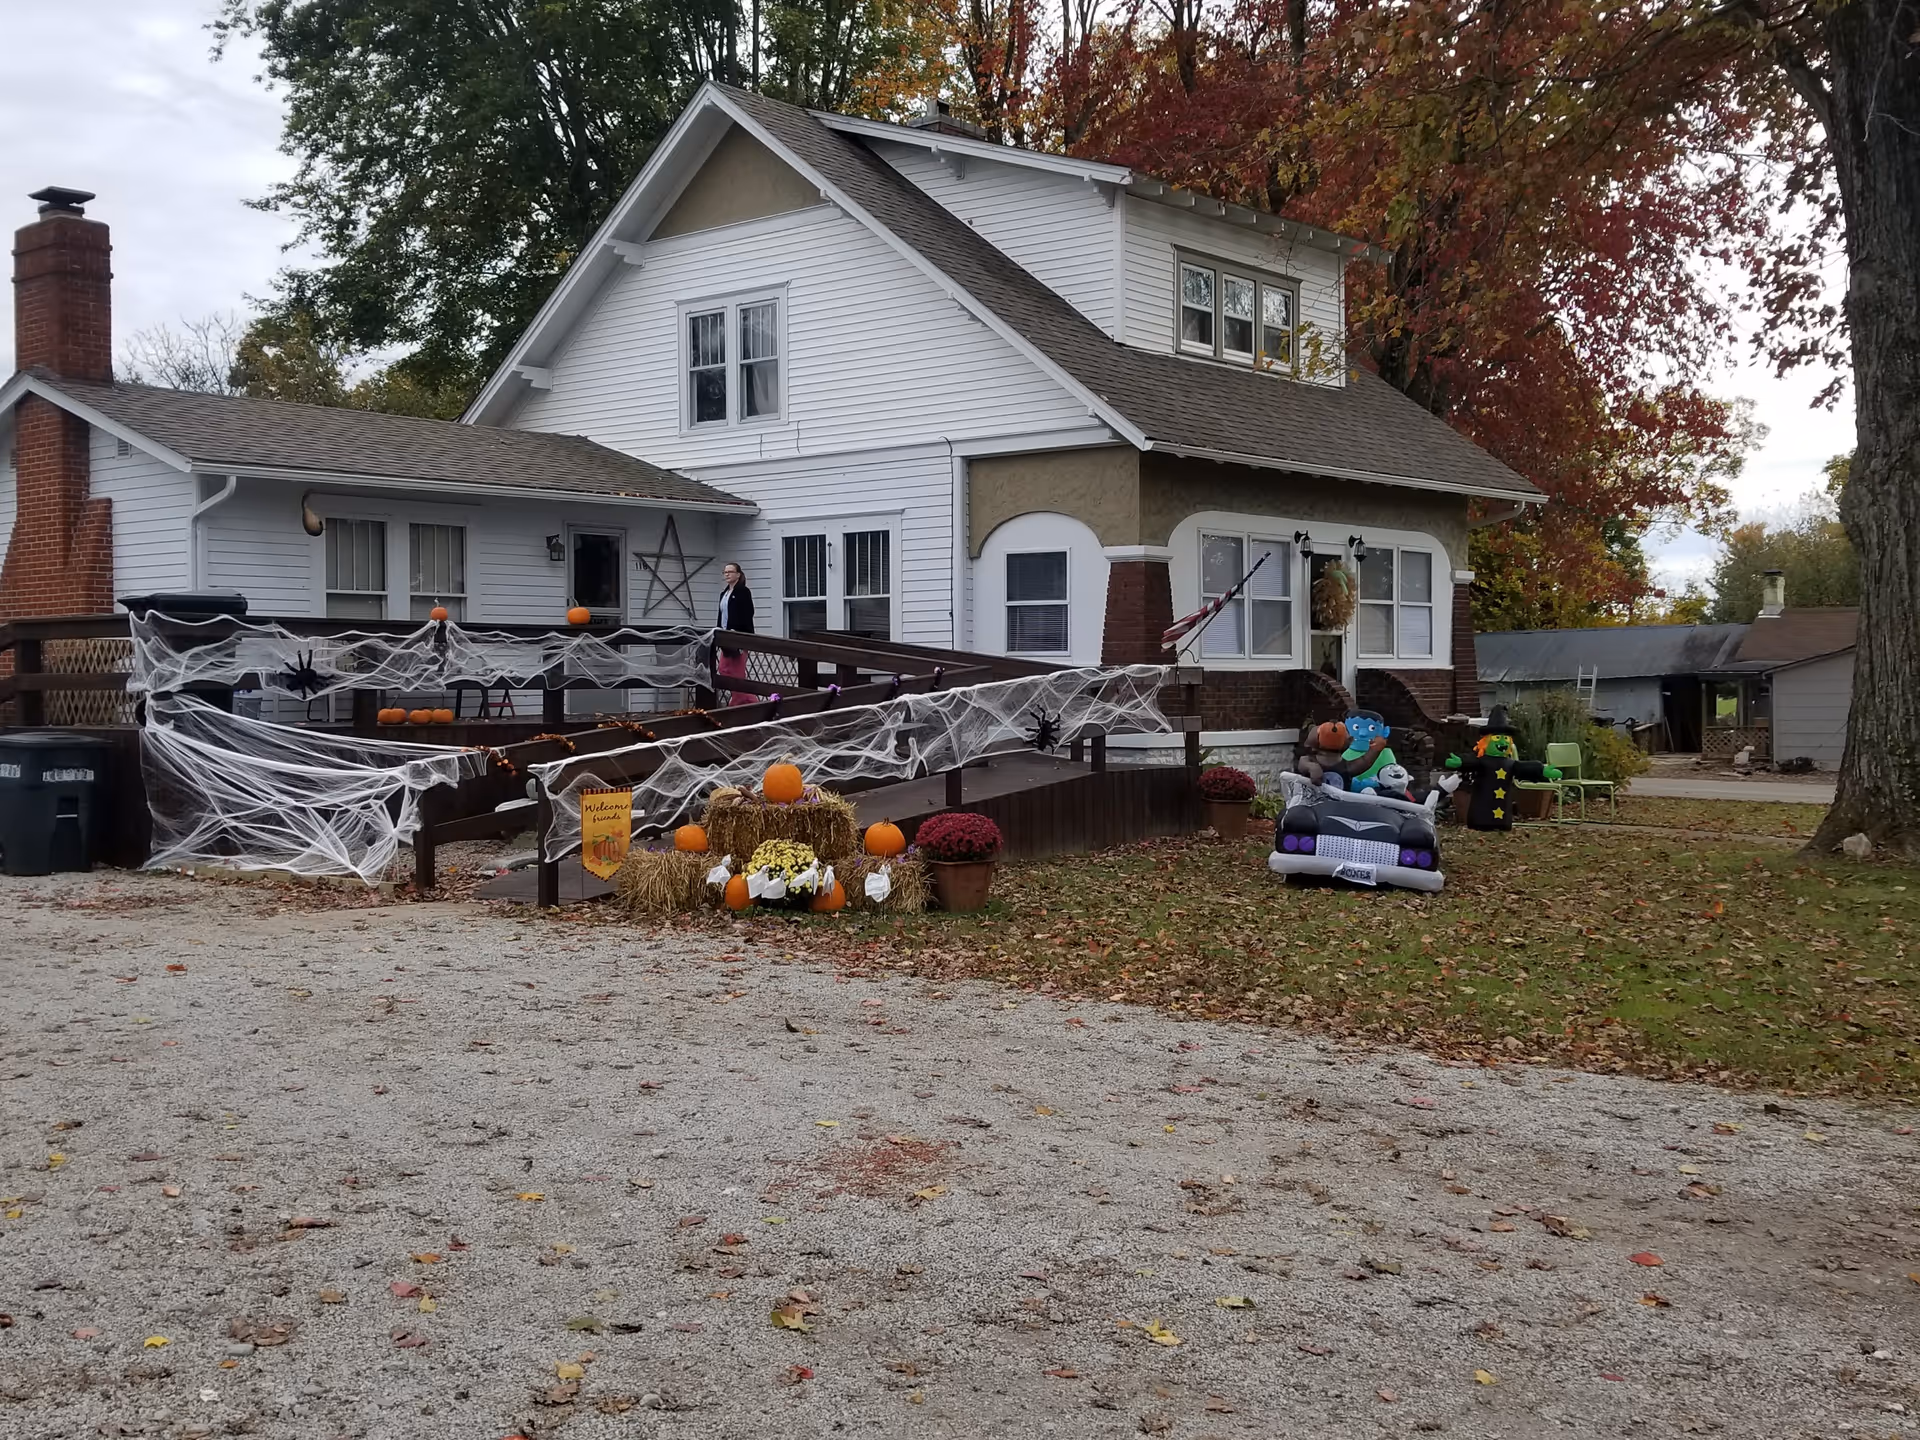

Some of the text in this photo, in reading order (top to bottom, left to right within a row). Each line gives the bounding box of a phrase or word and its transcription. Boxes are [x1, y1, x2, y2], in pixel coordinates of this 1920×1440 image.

[584, 801, 629, 812] Welcome
[592, 812, 621, 824] friends
[1340, 867, 1371, 880] BONES
